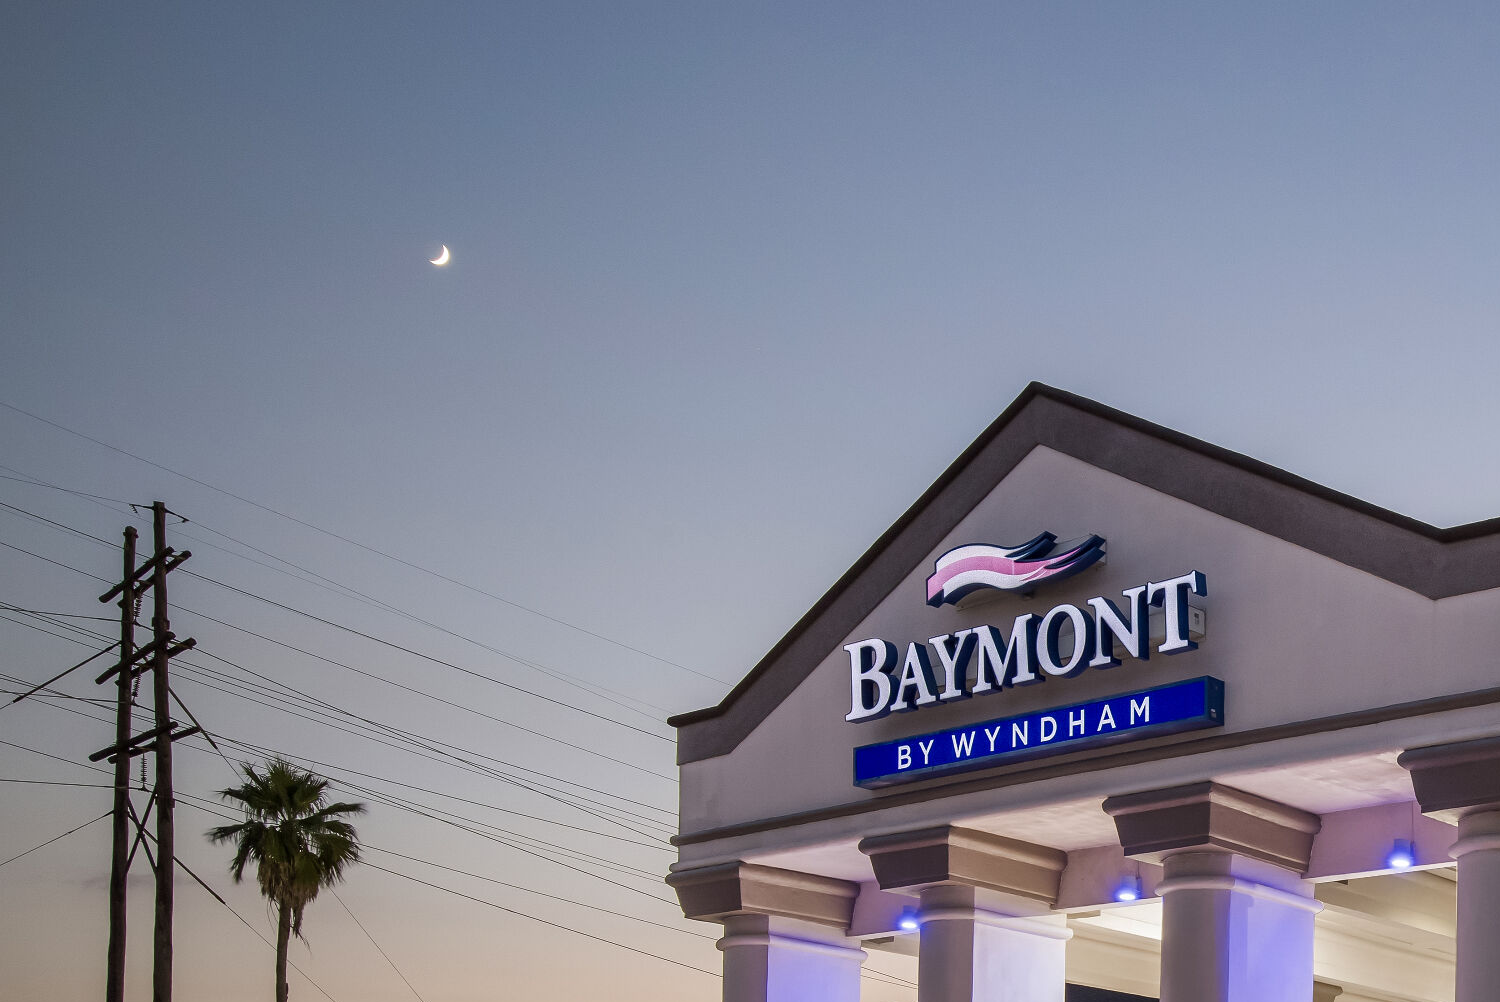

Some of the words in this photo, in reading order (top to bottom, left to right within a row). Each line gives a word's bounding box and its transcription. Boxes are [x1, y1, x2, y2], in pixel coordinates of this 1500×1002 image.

[843, 570, 1200, 722] BAYMONT
[897, 739, 934, 770] BY
[951, 696, 1150, 758] WYNDHAM
